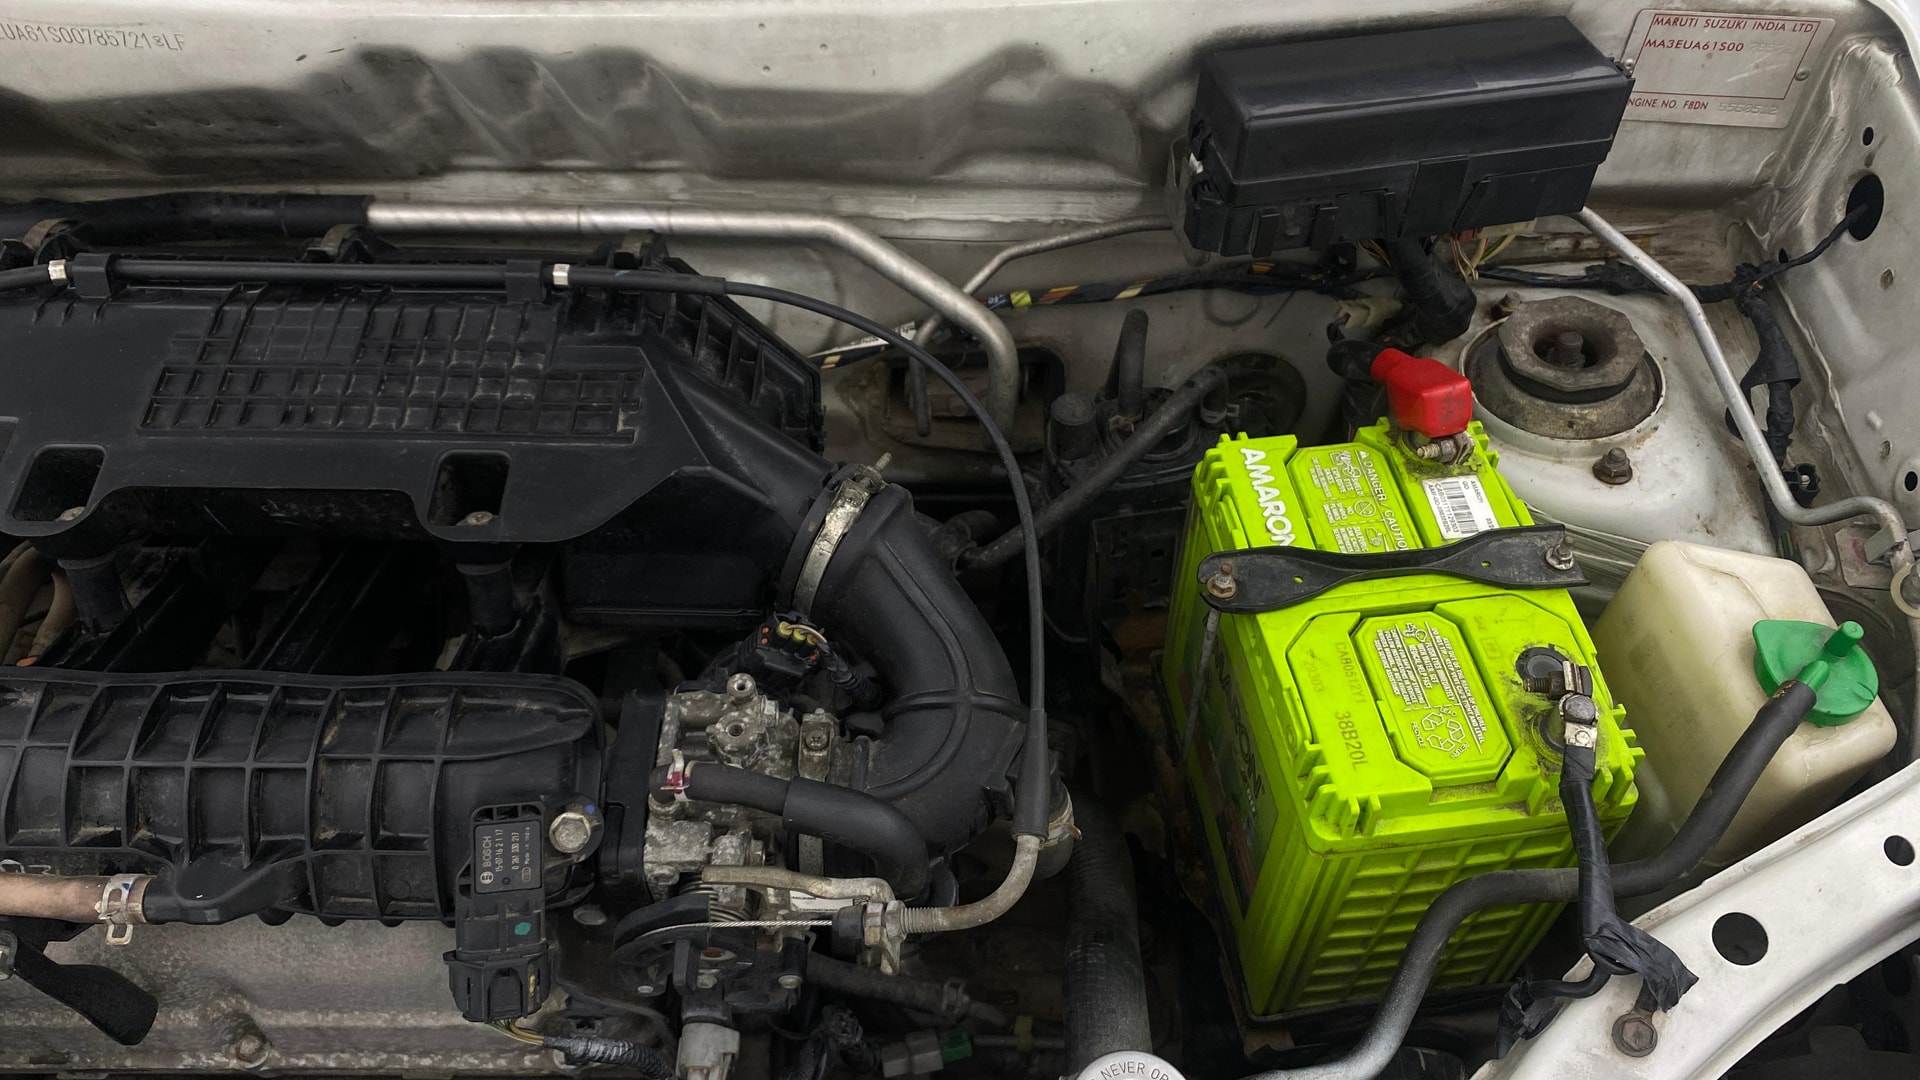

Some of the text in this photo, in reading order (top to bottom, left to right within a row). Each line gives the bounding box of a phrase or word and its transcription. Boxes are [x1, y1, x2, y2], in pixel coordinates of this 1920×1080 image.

[1653, 17, 1699, 28] MARUTI
[1703, 18, 1748, 30] SUZUKI
[1752, 21, 1786, 30] INDIA
[1644, 39, 1744, 52] MA3EUA61S00
[1626, 97, 1658, 108] NGINE
[1661, 99, 1678, 109] NO.
[1682, 100, 1708, 110] F8DN
[1363, 460, 1387, 500] DANGER
[1384, 510, 1408, 550] CAUTIO
[1334, 710, 1368, 771] 38B20L
[482, 836, 492, 868] BOSCH
[1100, 1061, 1146, 1080] NEVER
